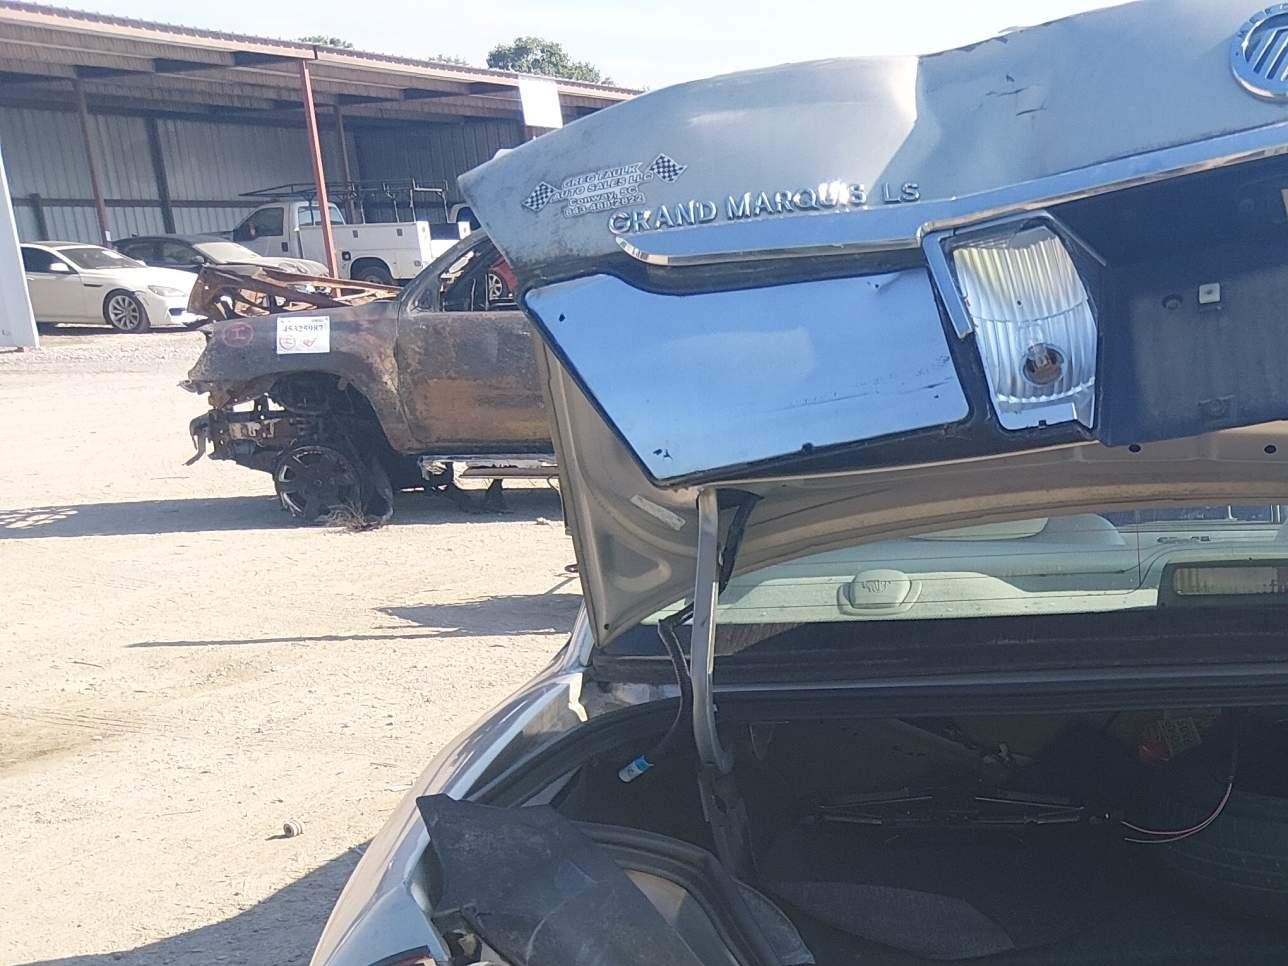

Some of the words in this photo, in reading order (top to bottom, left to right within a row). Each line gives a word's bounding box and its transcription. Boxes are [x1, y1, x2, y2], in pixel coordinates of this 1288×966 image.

[596, 163, 643, 181] FAULK
[552, 184, 586, 201] AUTO
[586, 177, 627, 193] SALES
[627, 170, 654, 185] LLC
[568, 190, 620, 206] Conway,
[619, 185, 640, 198] SC
[608, 199, 718, 236] GRAND
[726, 180, 867, 221] MARQUIS
[882, 182, 921, 202] LS
